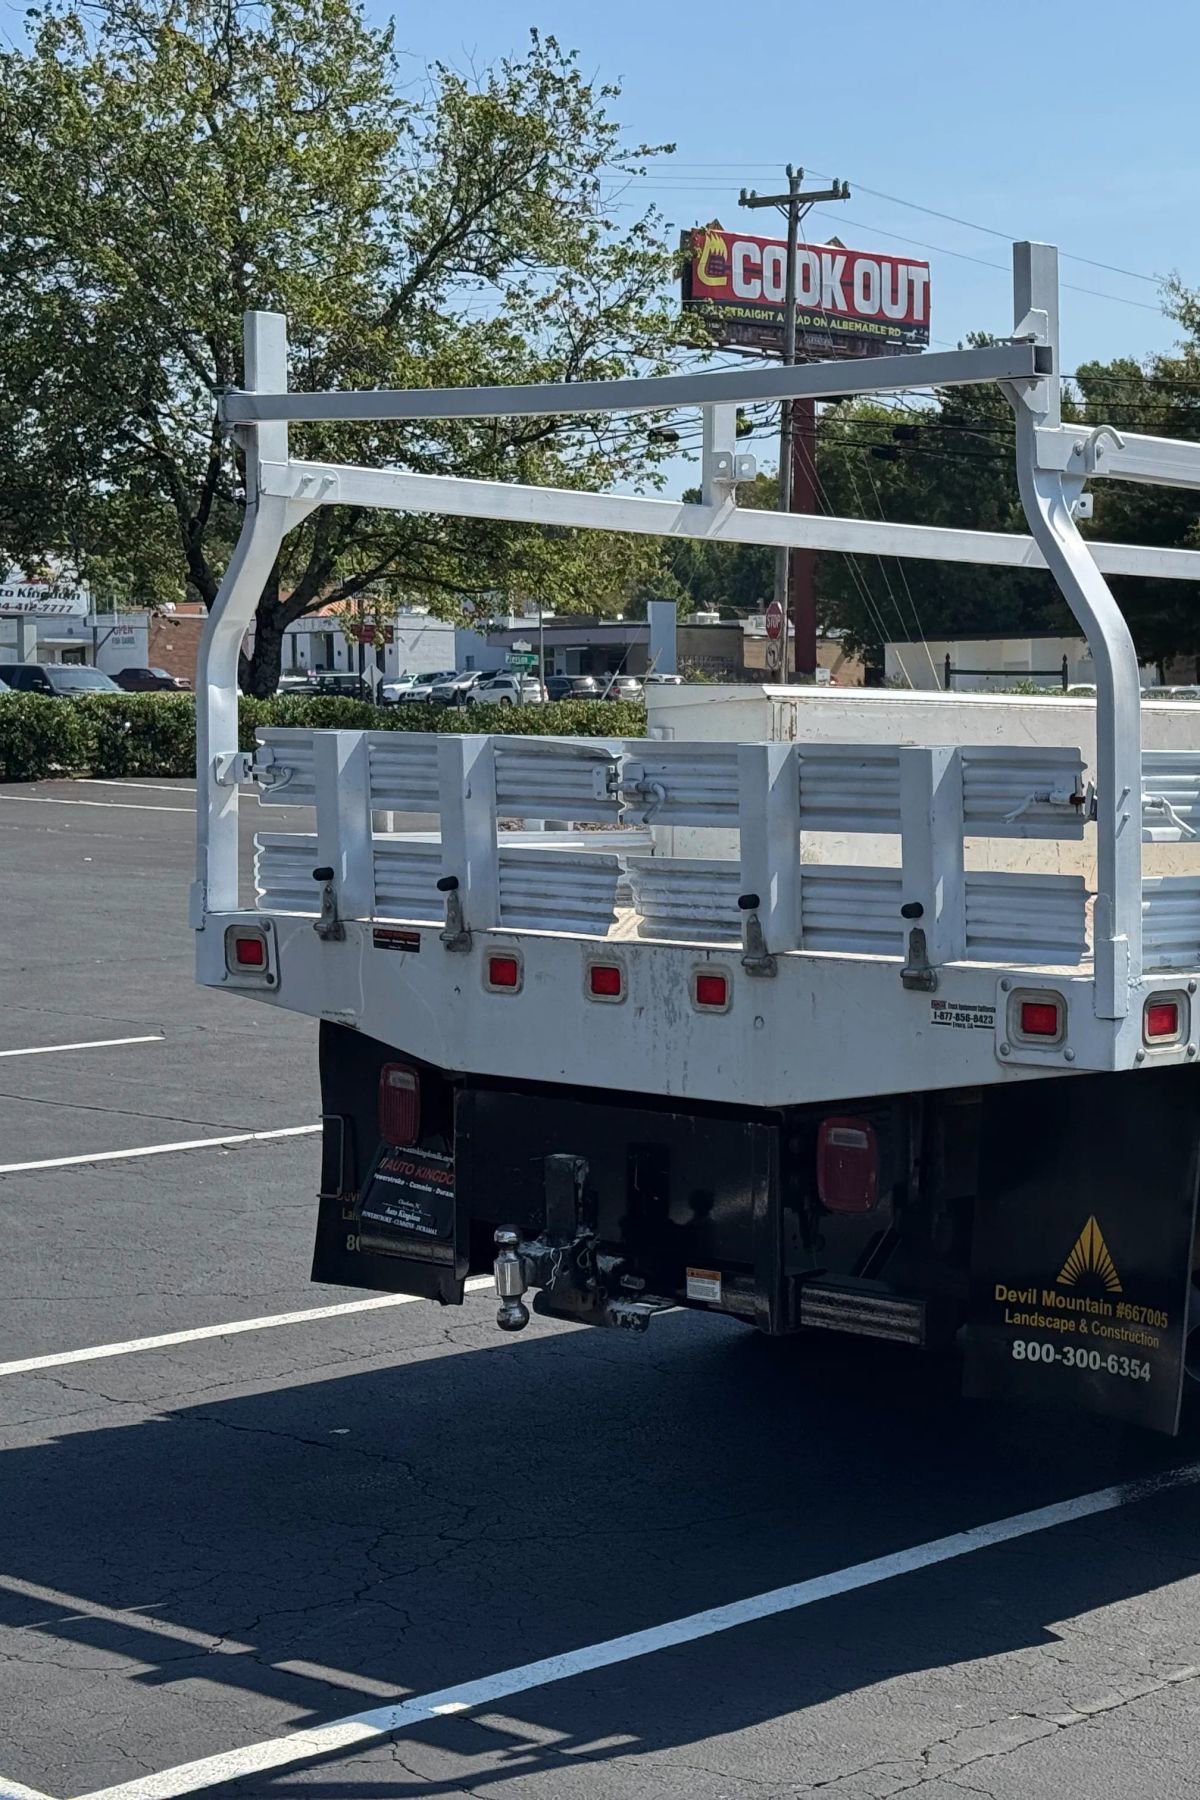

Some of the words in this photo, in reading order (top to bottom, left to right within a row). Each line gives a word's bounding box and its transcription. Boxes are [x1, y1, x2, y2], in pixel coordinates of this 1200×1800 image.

[731, 240, 848, 311] COOK
[853, 258, 929, 321] OUT
[723, 305, 775, 321] STRAIGHT
[776, 311, 811, 326] AAD
[813, 317, 828, 328] ON
[829, 318, 887, 335] ALBEMARLE
[887, 327, 902, 337] RD
[0, 602, 74, 614] 4-412-7777
[766, 613, 781, 629] STOP
[384, 1158, 415, 1176] AUTO
[415, 1166, 455, 1185] KINGDO
[435, 1187, 455, 1199] Duram
[994, 1284, 1037, 1305] Devil
[1041, 1290, 1112, 1316] Mountain
[1116, 1302, 1169, 1329] #667005
[1004, 1308, 1076, 1334] Landscape
[1079, 1318, 1089, 1334] &
[1091, 1321, 1159, 1349] Construction
[1011, 1339, 1152, 1382] 800-300-6354
